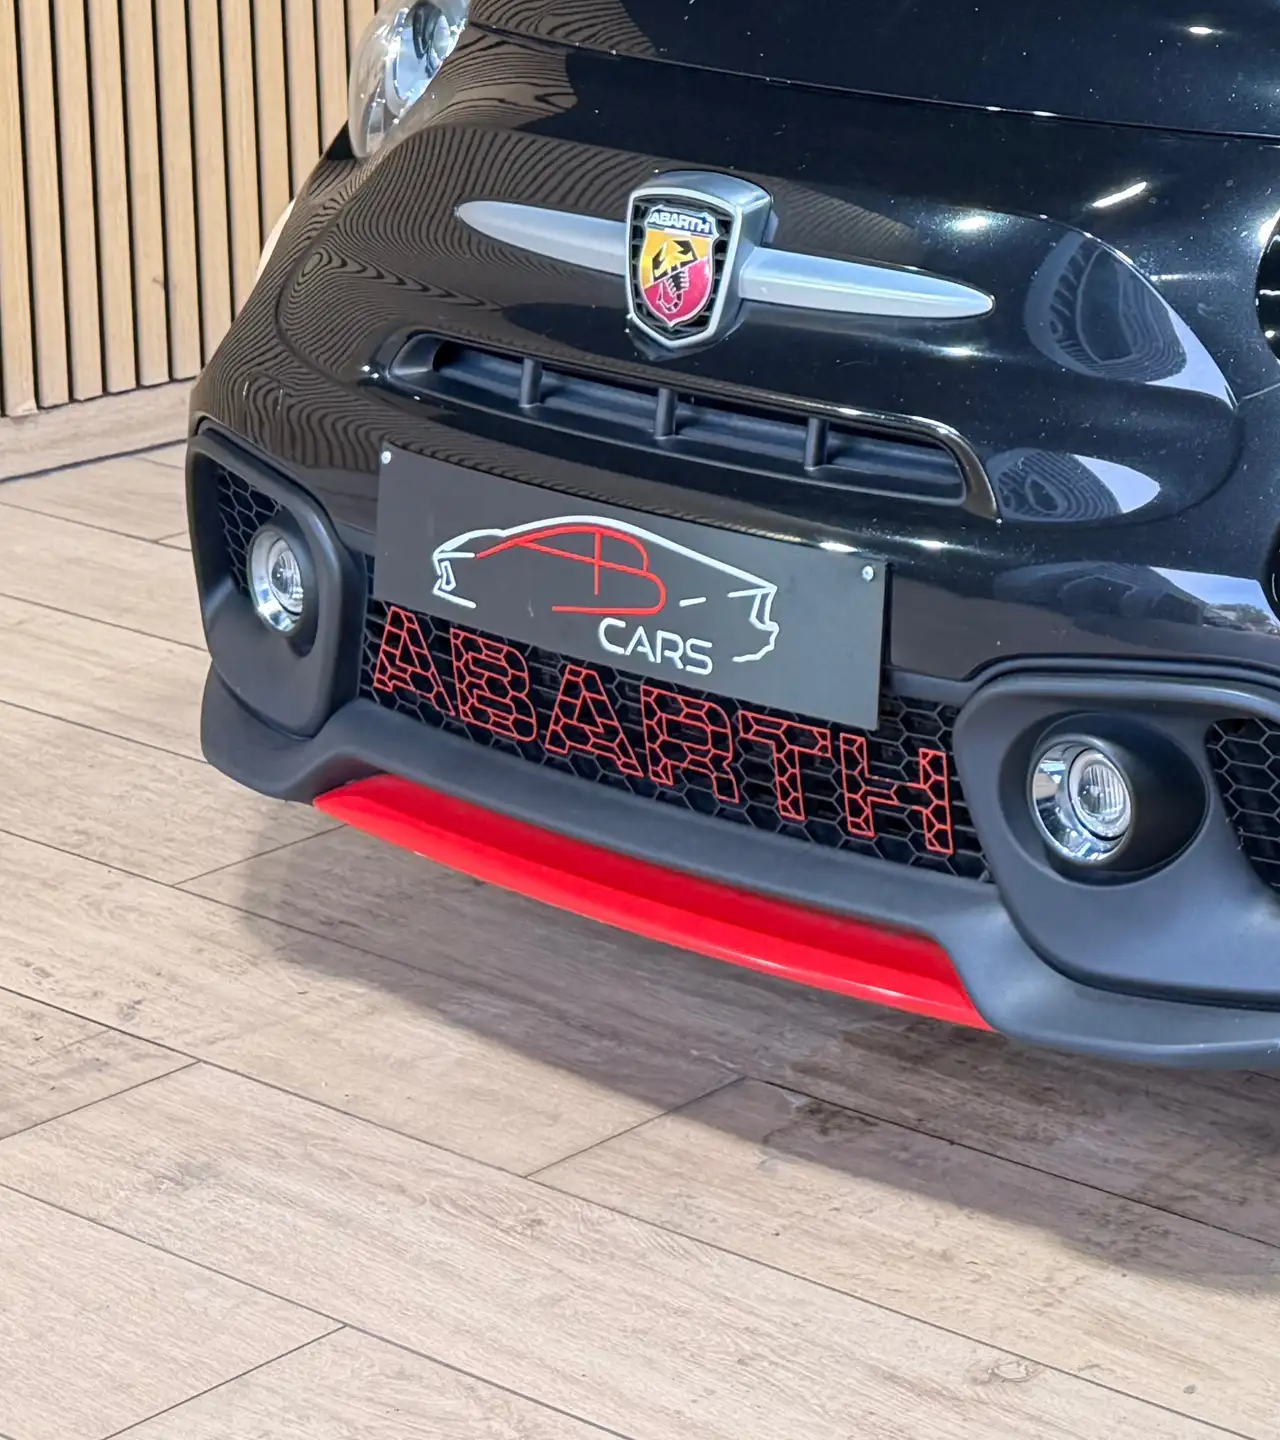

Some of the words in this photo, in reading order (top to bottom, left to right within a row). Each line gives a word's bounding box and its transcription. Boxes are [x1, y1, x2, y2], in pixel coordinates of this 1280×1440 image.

[648, 211, 710, 234] ABARTH
[598, 616, 714, 676] CARS
[373, 605, 954, 855] ABARTH
